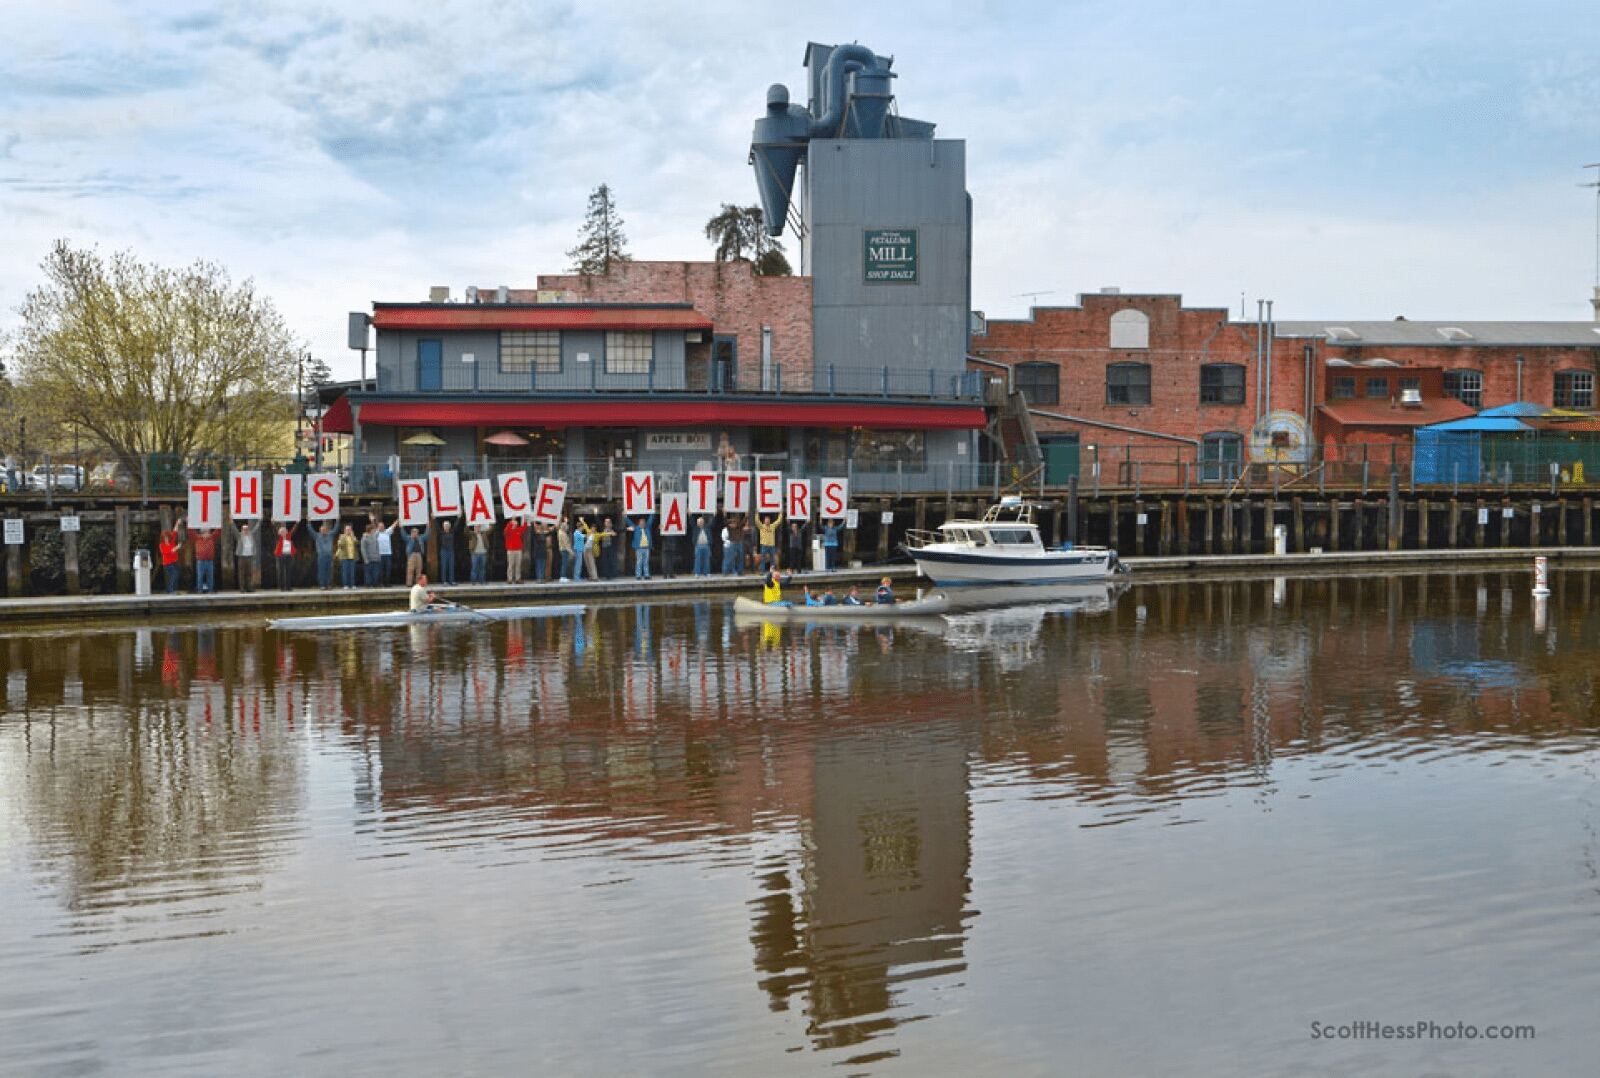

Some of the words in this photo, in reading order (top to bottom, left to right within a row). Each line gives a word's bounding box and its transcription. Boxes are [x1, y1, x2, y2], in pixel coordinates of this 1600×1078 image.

[870, 247, 913, 261] MILL
[651, 433, 682, 444] APPLE
[191, 476, 335, 523] THIS
[401, 476, 565, 523] PLACE
[624, 474, 843, 531] MATTERS
